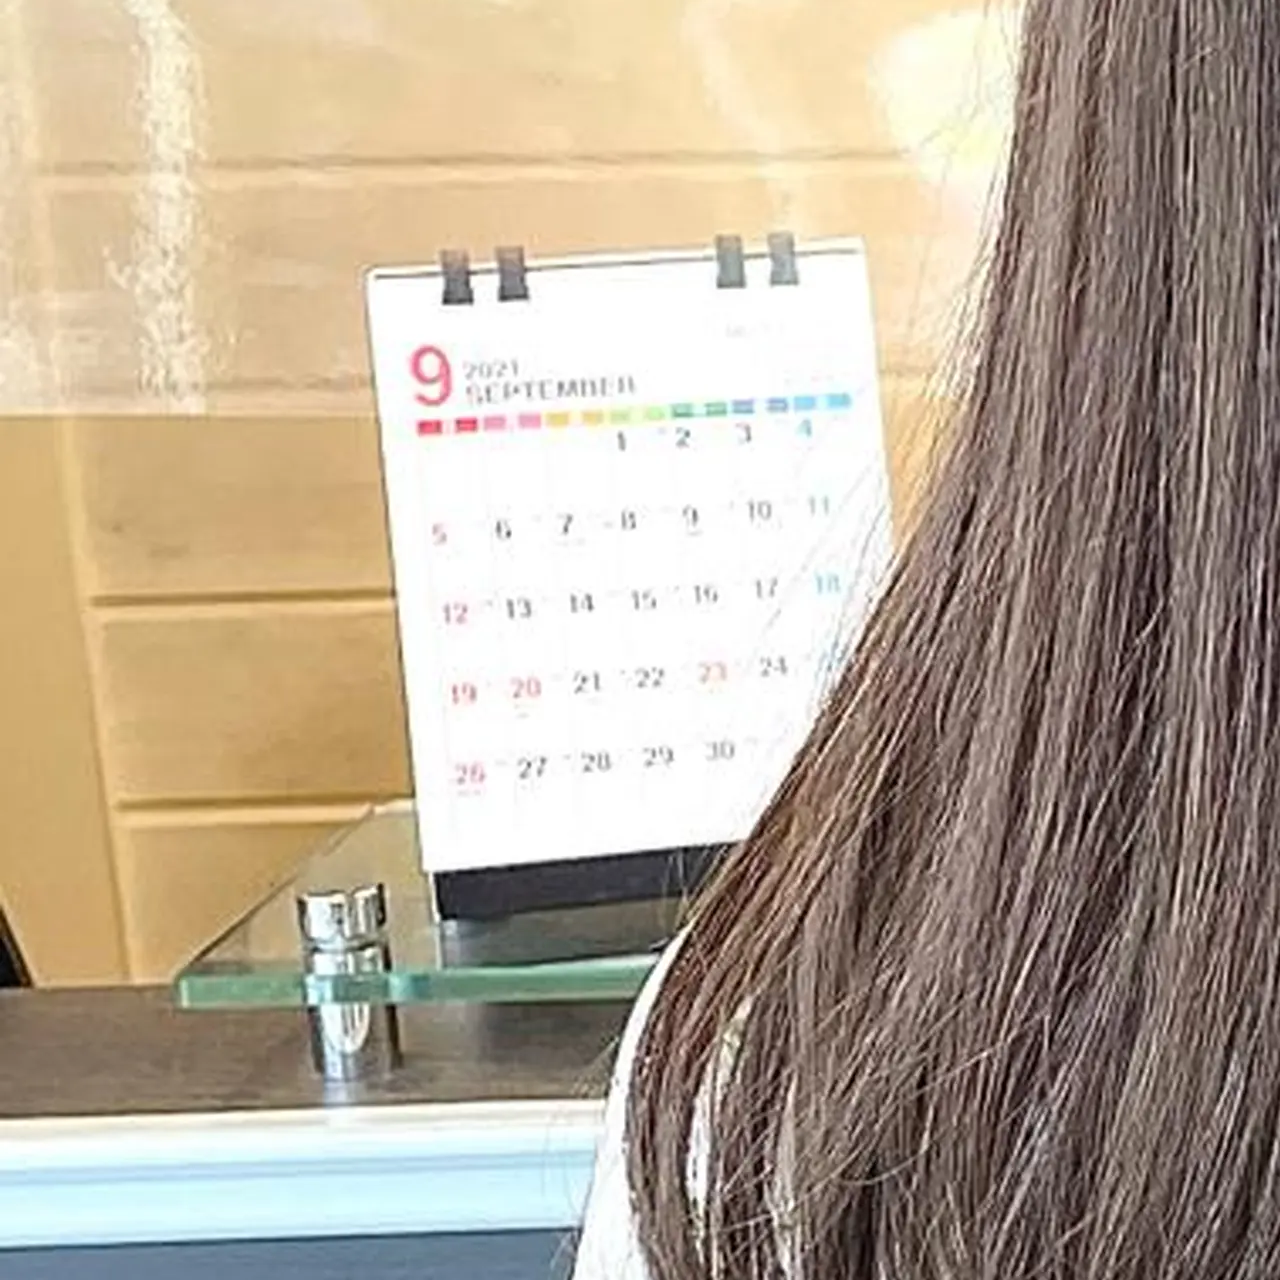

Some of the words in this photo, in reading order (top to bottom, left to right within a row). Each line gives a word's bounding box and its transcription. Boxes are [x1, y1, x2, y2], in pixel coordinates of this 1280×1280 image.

[410, 345, 452, 406] 9
[464, 358, 518, 380] 2021
[465, 376, 635, 404] SEPTEMBER
[615, 430, 626, 451] 1
[675, 427, 691, 448] 2
[736, 422, 752, 445] 3
[432, 523, 447, 545] 5
[495, 519, 512, 540] 6
[557, 513, 573, 535] 7
[620, 508, 636, 530] 8
[682, 504, 698, 528] 9
[748, 498, 772, 522] 10
[442, 601, 468, 625] 12
[506, 597, 532, 620] 13
[569, 592, 594, 614] 14
[631, 588, 657, 611] 15
[694, 582, 718, 604] 16
[755, 577, 778, 599] 17
[451, 682, 477, 705] 19
[509, 675, 542, 699] 20
[573, 670, 600, 695] 21
[635, 666, 665, 689] 22
[699, 660, 727, 684] 23
[760, 655, 788, 678] 24
[455, 761, 486, 786] 26
[517, 755, 547, 780] 27
[581, 749, 611, 773] 28
[643, 745, 674, 767] 29
[705, 740, 735, 761] 30
